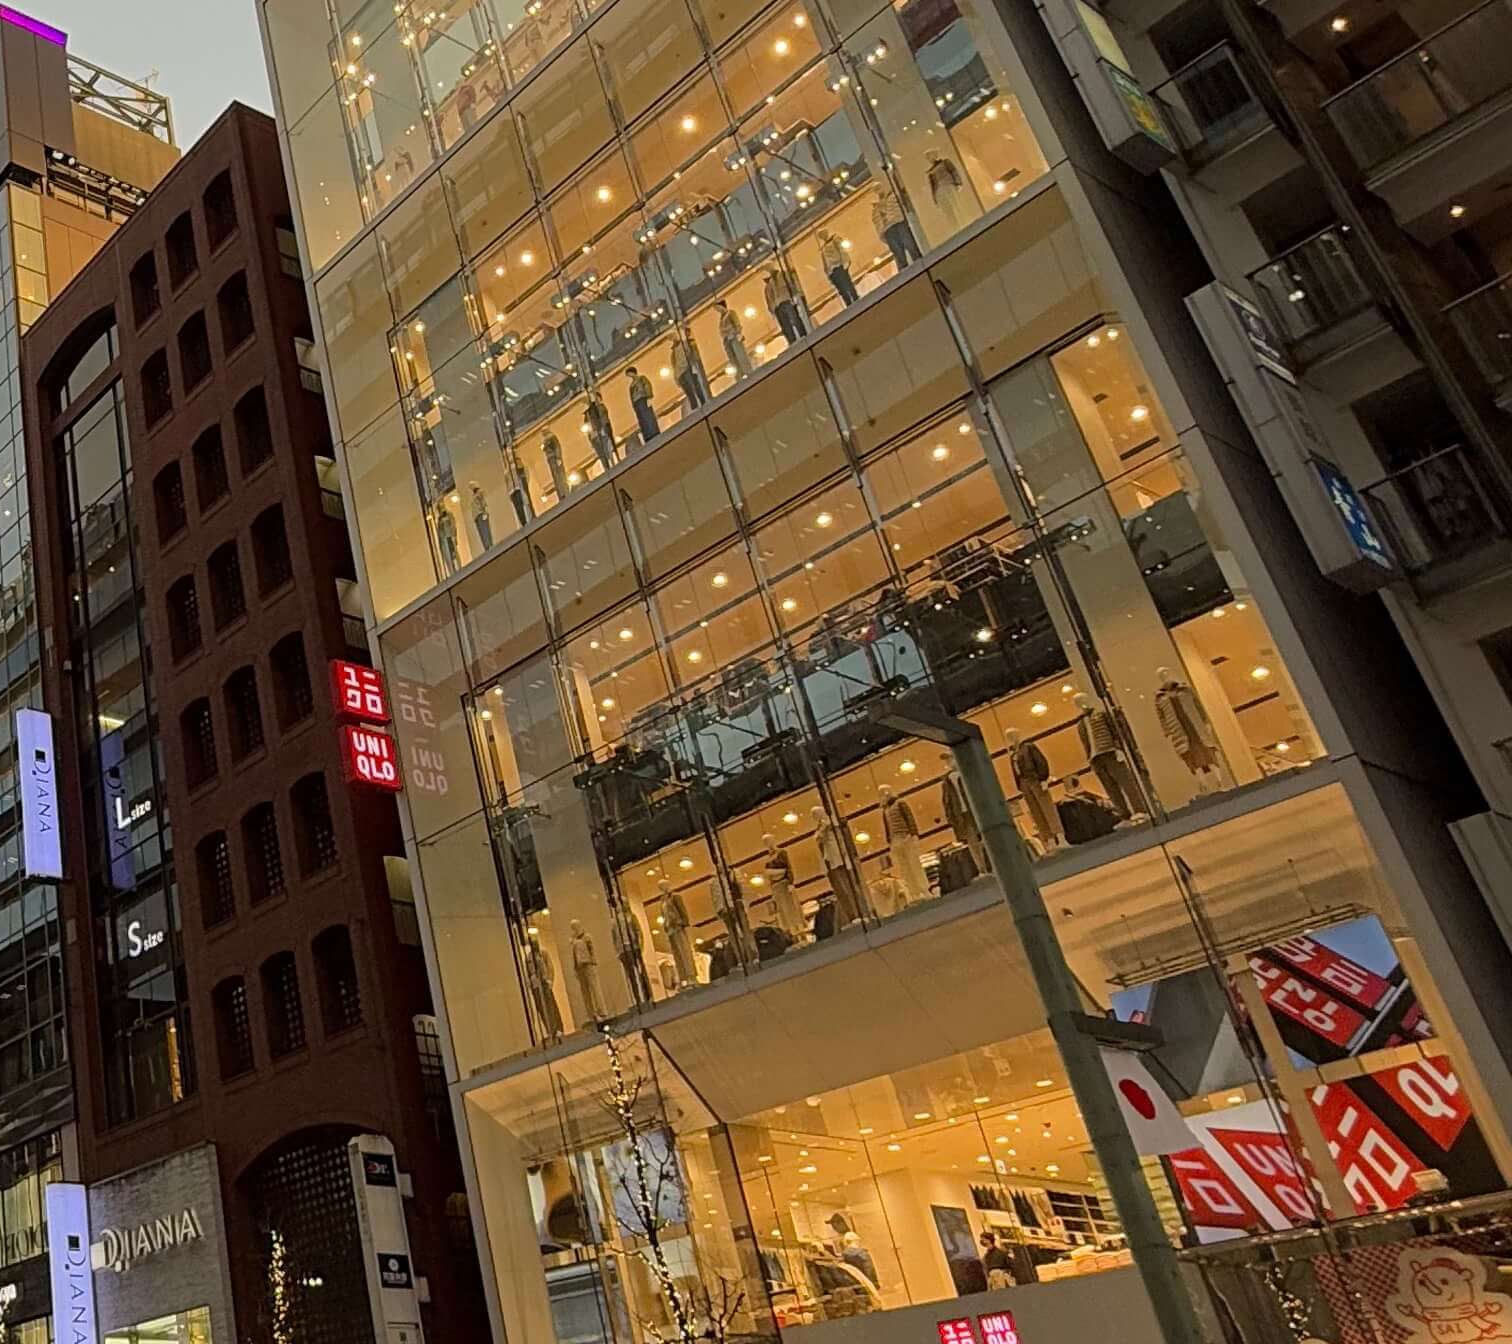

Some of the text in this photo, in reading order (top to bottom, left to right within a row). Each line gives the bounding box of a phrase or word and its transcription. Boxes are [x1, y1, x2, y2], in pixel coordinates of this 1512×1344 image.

[352, 731, 388, 758] UNI
[356, 755, 395, 781] QLO
[32, 749, 52, 833] DIANA
[90, 1207, 204, 1273] DIANA
[981, 1315, 1011, 1333] UNI
